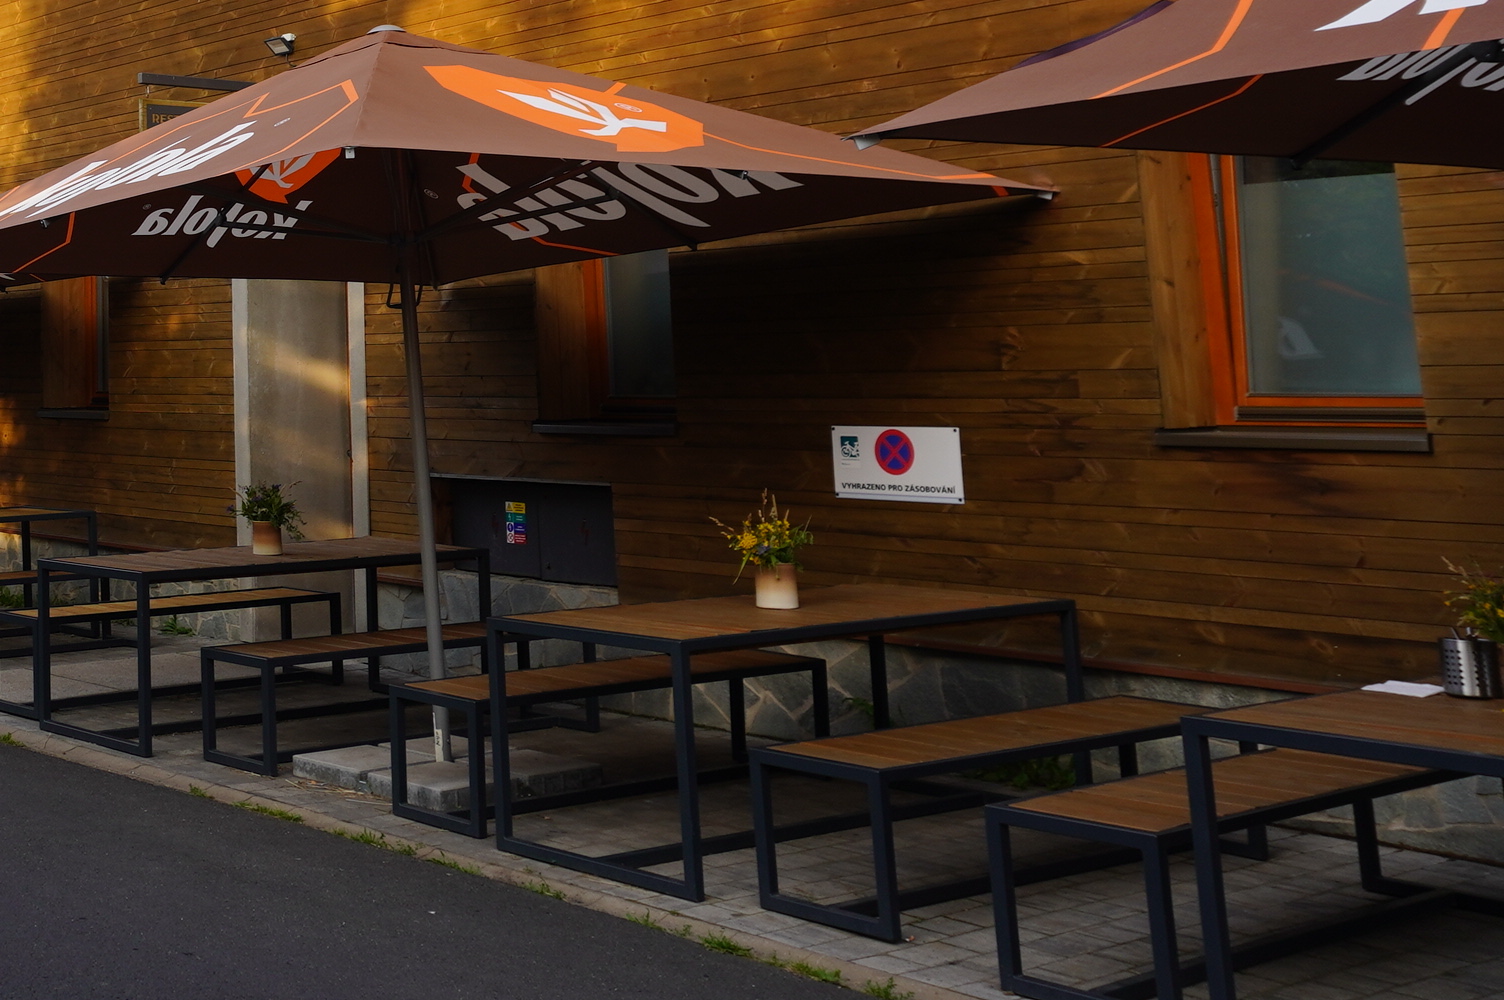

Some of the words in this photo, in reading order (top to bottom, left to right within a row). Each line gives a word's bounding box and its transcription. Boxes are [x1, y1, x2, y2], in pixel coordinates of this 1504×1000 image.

[152, 113, 179, 124] RES
[841, 482, 886, 491] VYHRAZENO
[888, 484, 903, 492] PRO
[904, 484, 956, 494] ZÁSOBOVÁNÍ
